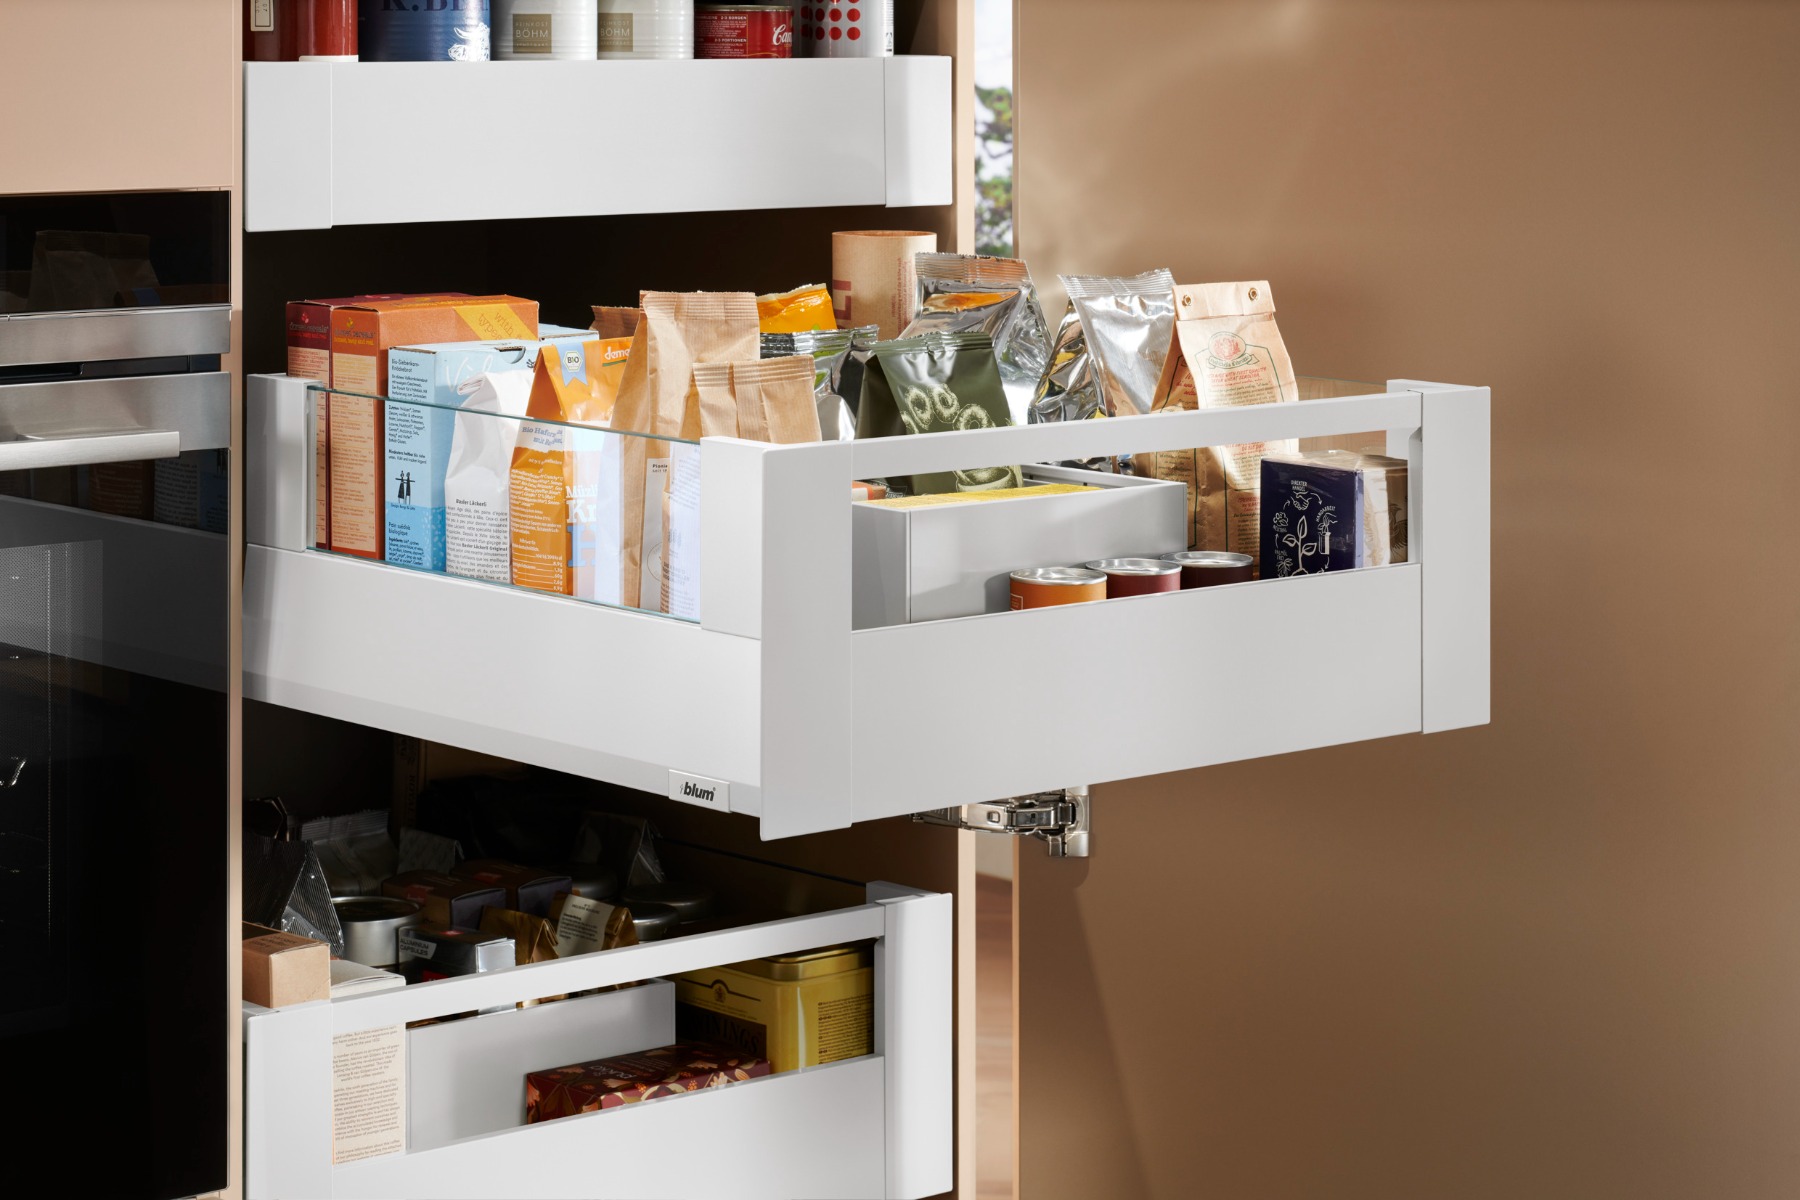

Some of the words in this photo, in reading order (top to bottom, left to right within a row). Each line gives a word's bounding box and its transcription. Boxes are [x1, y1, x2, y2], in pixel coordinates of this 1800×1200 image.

[516, 28, 548, 38] BÖHM
[684, 782, 714, 802] blum
[400, 944, 428, 956] CAPSULES
